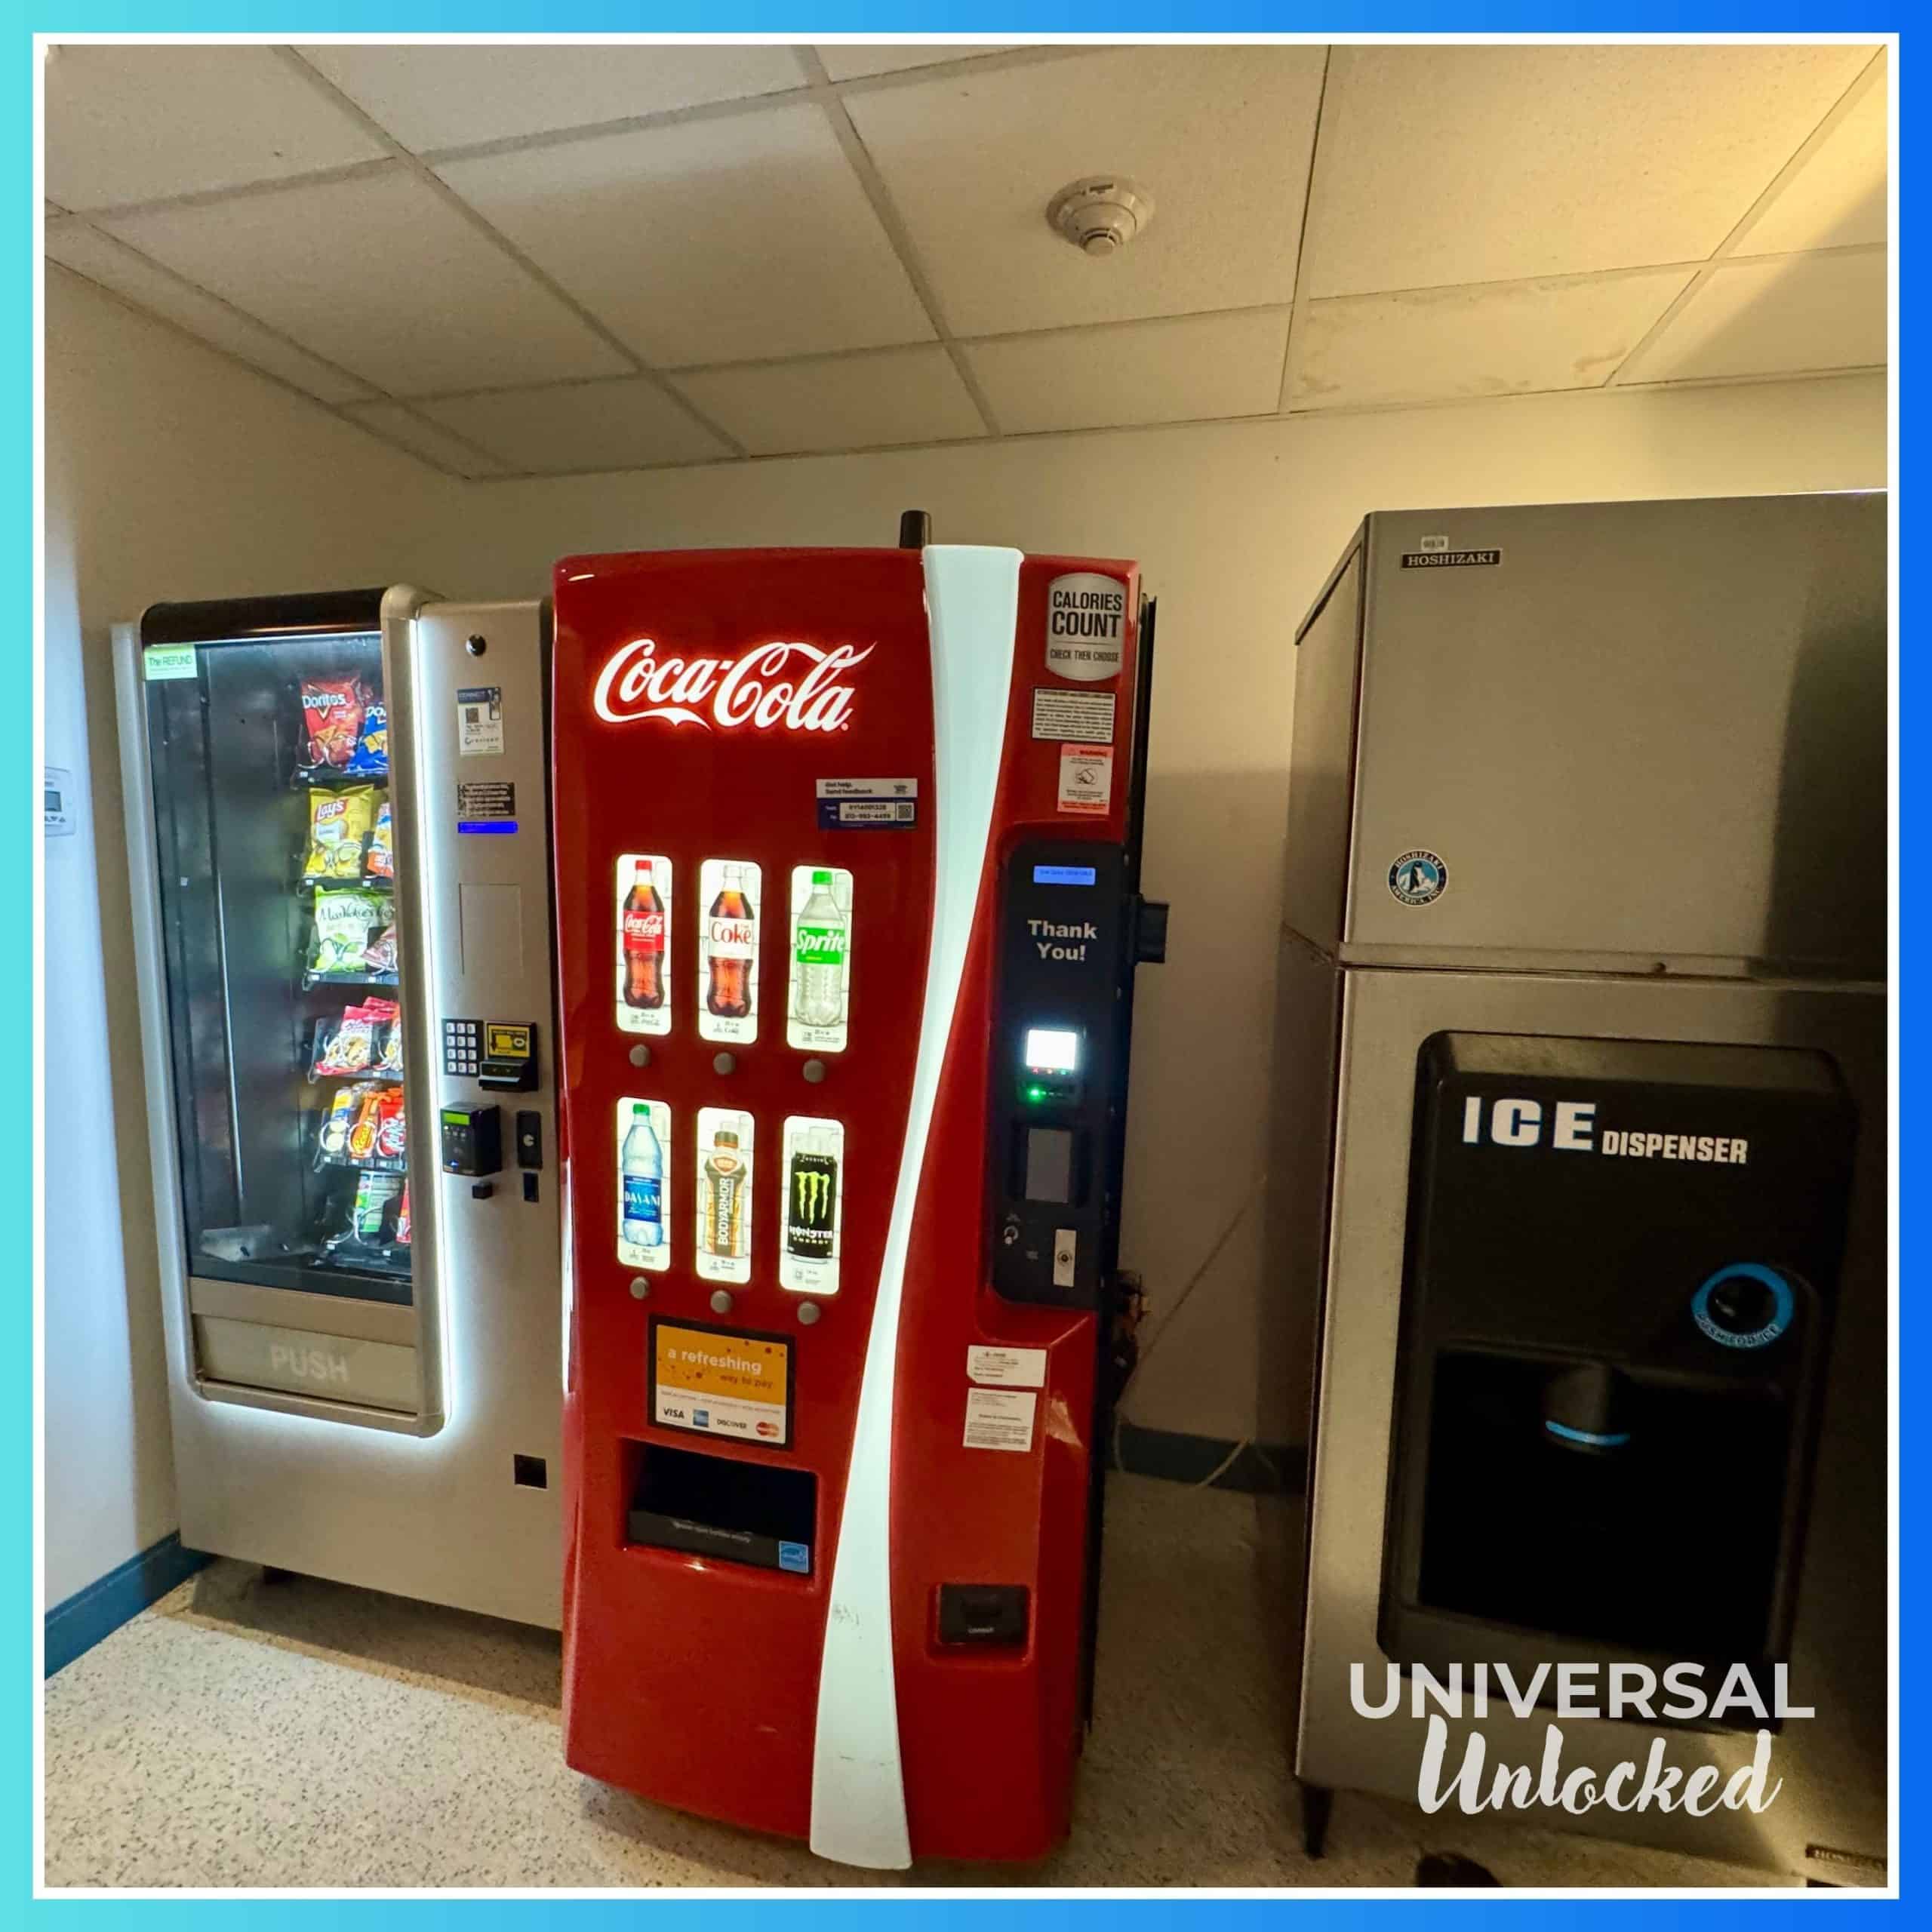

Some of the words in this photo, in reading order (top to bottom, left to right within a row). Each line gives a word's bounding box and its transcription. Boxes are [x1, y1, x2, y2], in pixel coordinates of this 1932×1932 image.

[1407, 552, 1495, 567] HOSHIZAKI
[1052, 590, 1123, 611] CALORIES
[1051, 611, 1122, 638] COUNT
[149, 657, 162, 666] The
[162, 654, 194, 666] REFUND
[1050, 648, 1071, 660] CHECK
[1073, 649, 1091, 661] THEN
[1093, 651, 1120, 663] CHOOSE
[594, 638, 877, 732] Coca-Cola
[301, 693, 346, 709] Doritos
[624, 912, 664, 937] Coca-Cola
[711, 920, 752, 946] Coke
[1027, 918, 1099, 940] Thank
[797, 929, 846, 955] Sprite
[1036, 942, 1087, 961] You!
[1462, 1096, 1597, 1152] ICE
[1601, 1129, 1749, 1165] DISPENSER
[717, 1177, 734, 1247] BODYARMOR
[271, 1346, 349, 1383] PUSH
[667, 1348, 677, 1360] a
[681, 1350, 762, 1377] refreshing
[663, 1407, 685, 1420] VISA
[716, 1418, 748, 1430] DISCOVER
